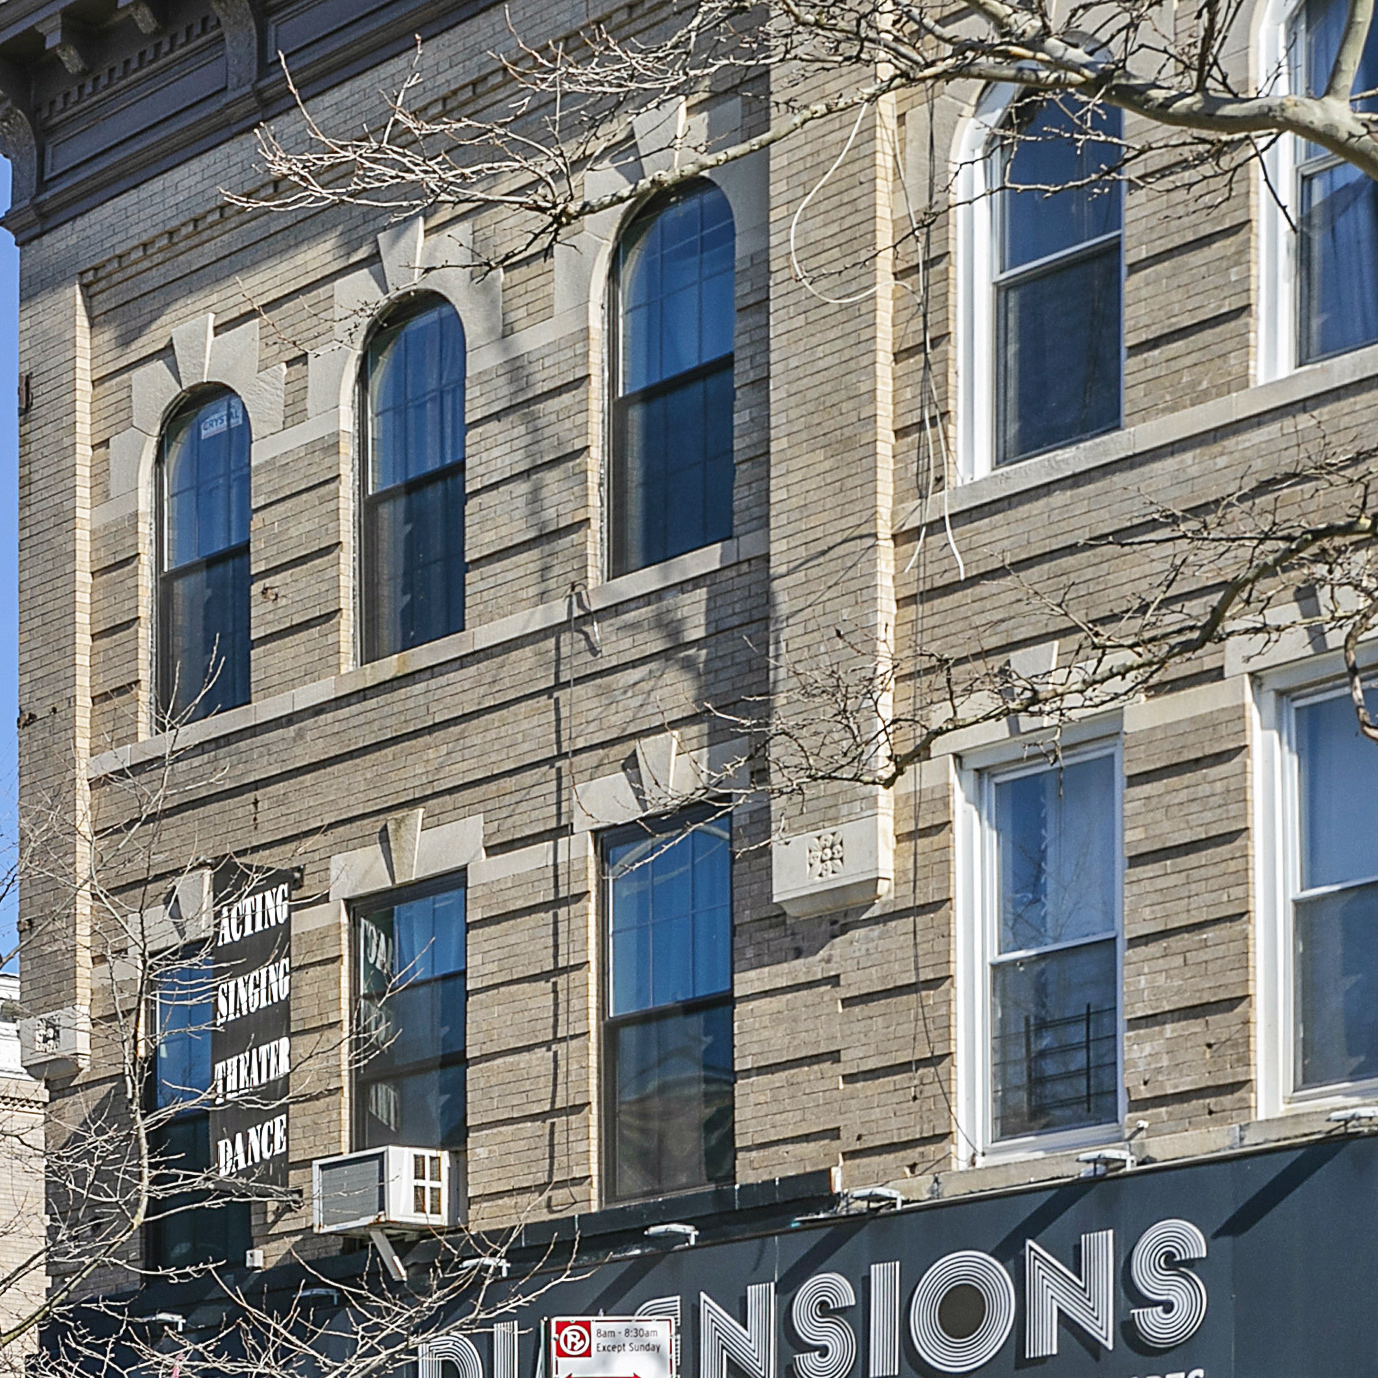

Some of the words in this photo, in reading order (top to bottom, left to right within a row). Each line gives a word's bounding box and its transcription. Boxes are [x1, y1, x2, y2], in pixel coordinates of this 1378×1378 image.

[217, 883, 289, 947] ACTING
[216, 957, 291, 1026] SINGING
[214, 1036, 291, 1105] THEATER
[217, 1114, 287, 1177] DANCE
[596, 1328, 615, 1337] 8am
[624, 1328, 658, 1338] 8:30am
[596, 1343, 626, 1353] Except
[629, 1342, 661, 1353] Sunday
